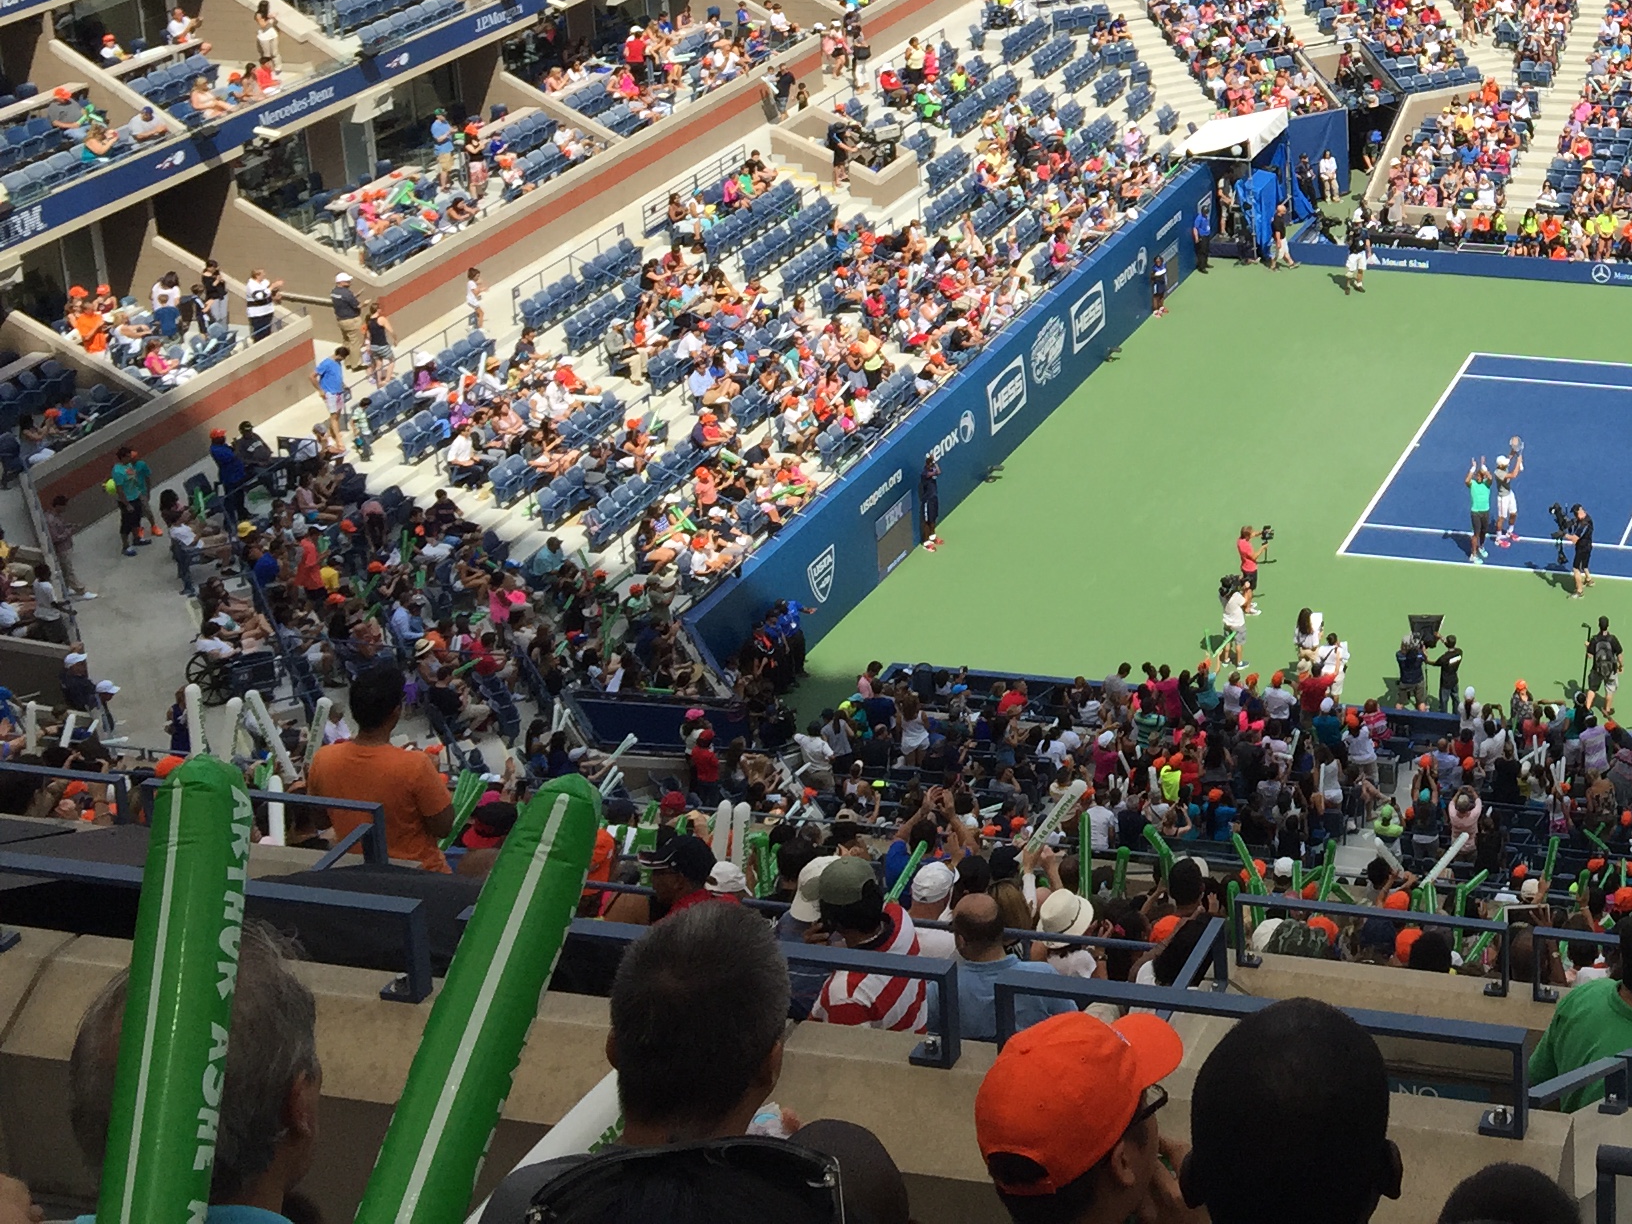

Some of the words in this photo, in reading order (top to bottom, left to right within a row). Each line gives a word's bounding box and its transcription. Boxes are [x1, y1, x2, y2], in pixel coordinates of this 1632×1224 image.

[258, 85, 336, 126] Mercedes-Benz
[1113, 259, 1139, 293] xerox
[1075, 296, 1103, 337] HESS
[992, 372, 1023, 418] HESS
[860, 468, 903, 516] usopen.org
